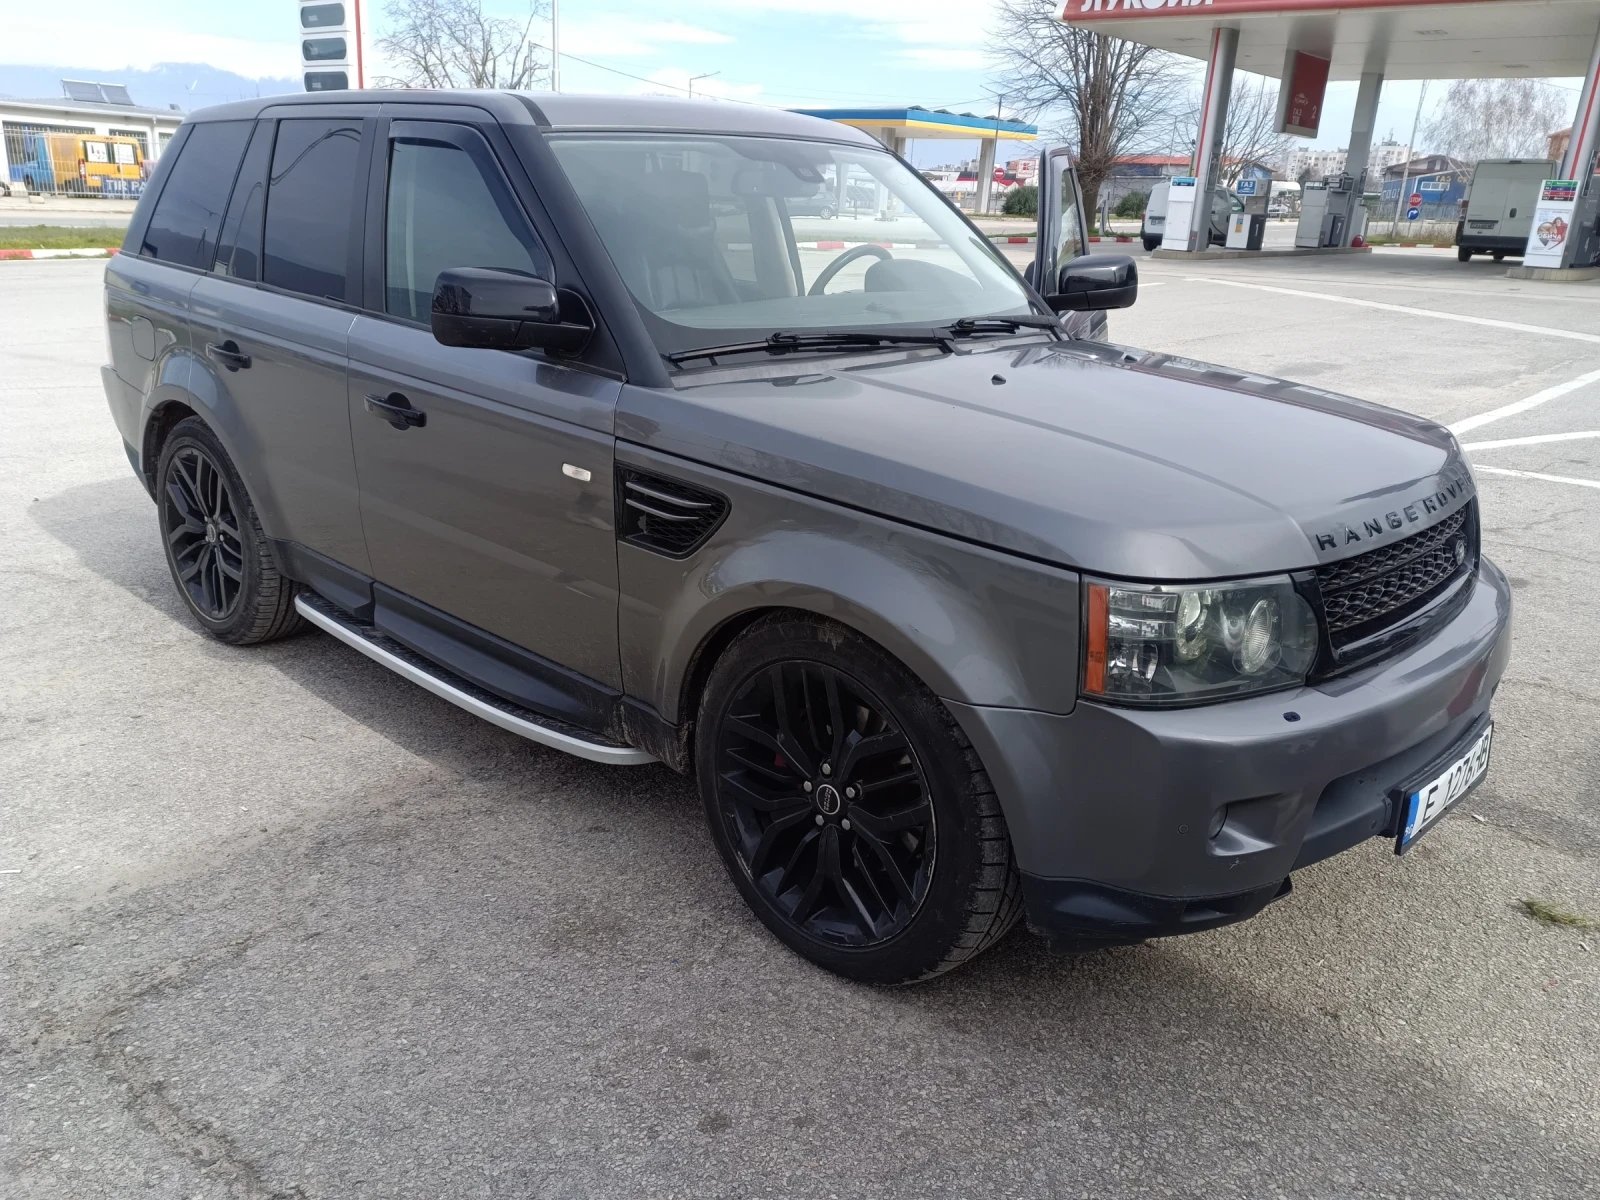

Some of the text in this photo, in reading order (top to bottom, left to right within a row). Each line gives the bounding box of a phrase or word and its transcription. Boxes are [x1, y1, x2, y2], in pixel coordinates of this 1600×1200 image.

[1311, 105, 1317, 119] 2
[106, 179, 127, 190] TIR
[1240, 180, 1254, 188] ГАЗ
[1315, 505, 1419, 551] RANGE
